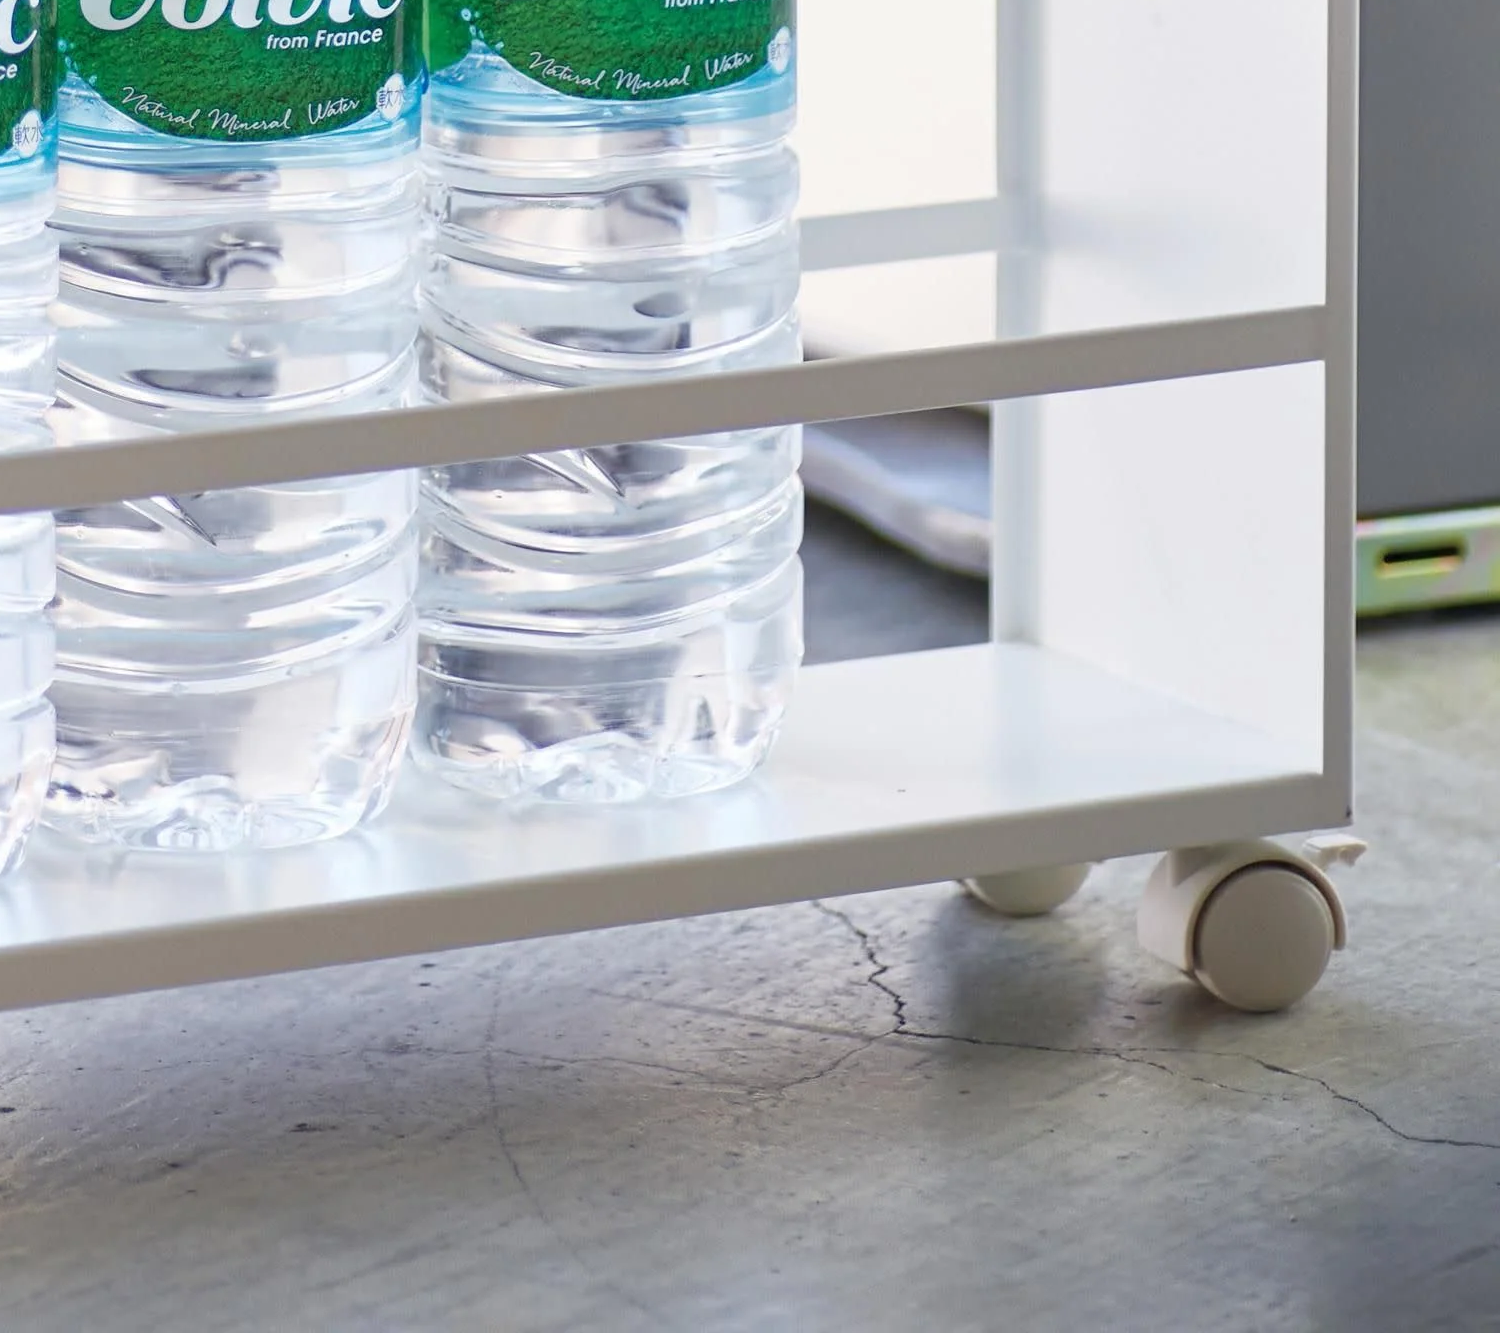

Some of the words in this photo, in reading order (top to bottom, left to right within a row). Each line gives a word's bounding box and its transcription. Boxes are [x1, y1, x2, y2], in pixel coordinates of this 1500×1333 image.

[266, 33, 309, 50] from
[314, 26, 383, 48] France
[528, 51, 605, 91] Natural
[611, 64, 691, 96] Mineral
[703, 50, 754, 81] Water
[121, 86, 201, 129] Natural
[207, 107, 293, 136] Mineral
[307, 97, 360, 125] Water
